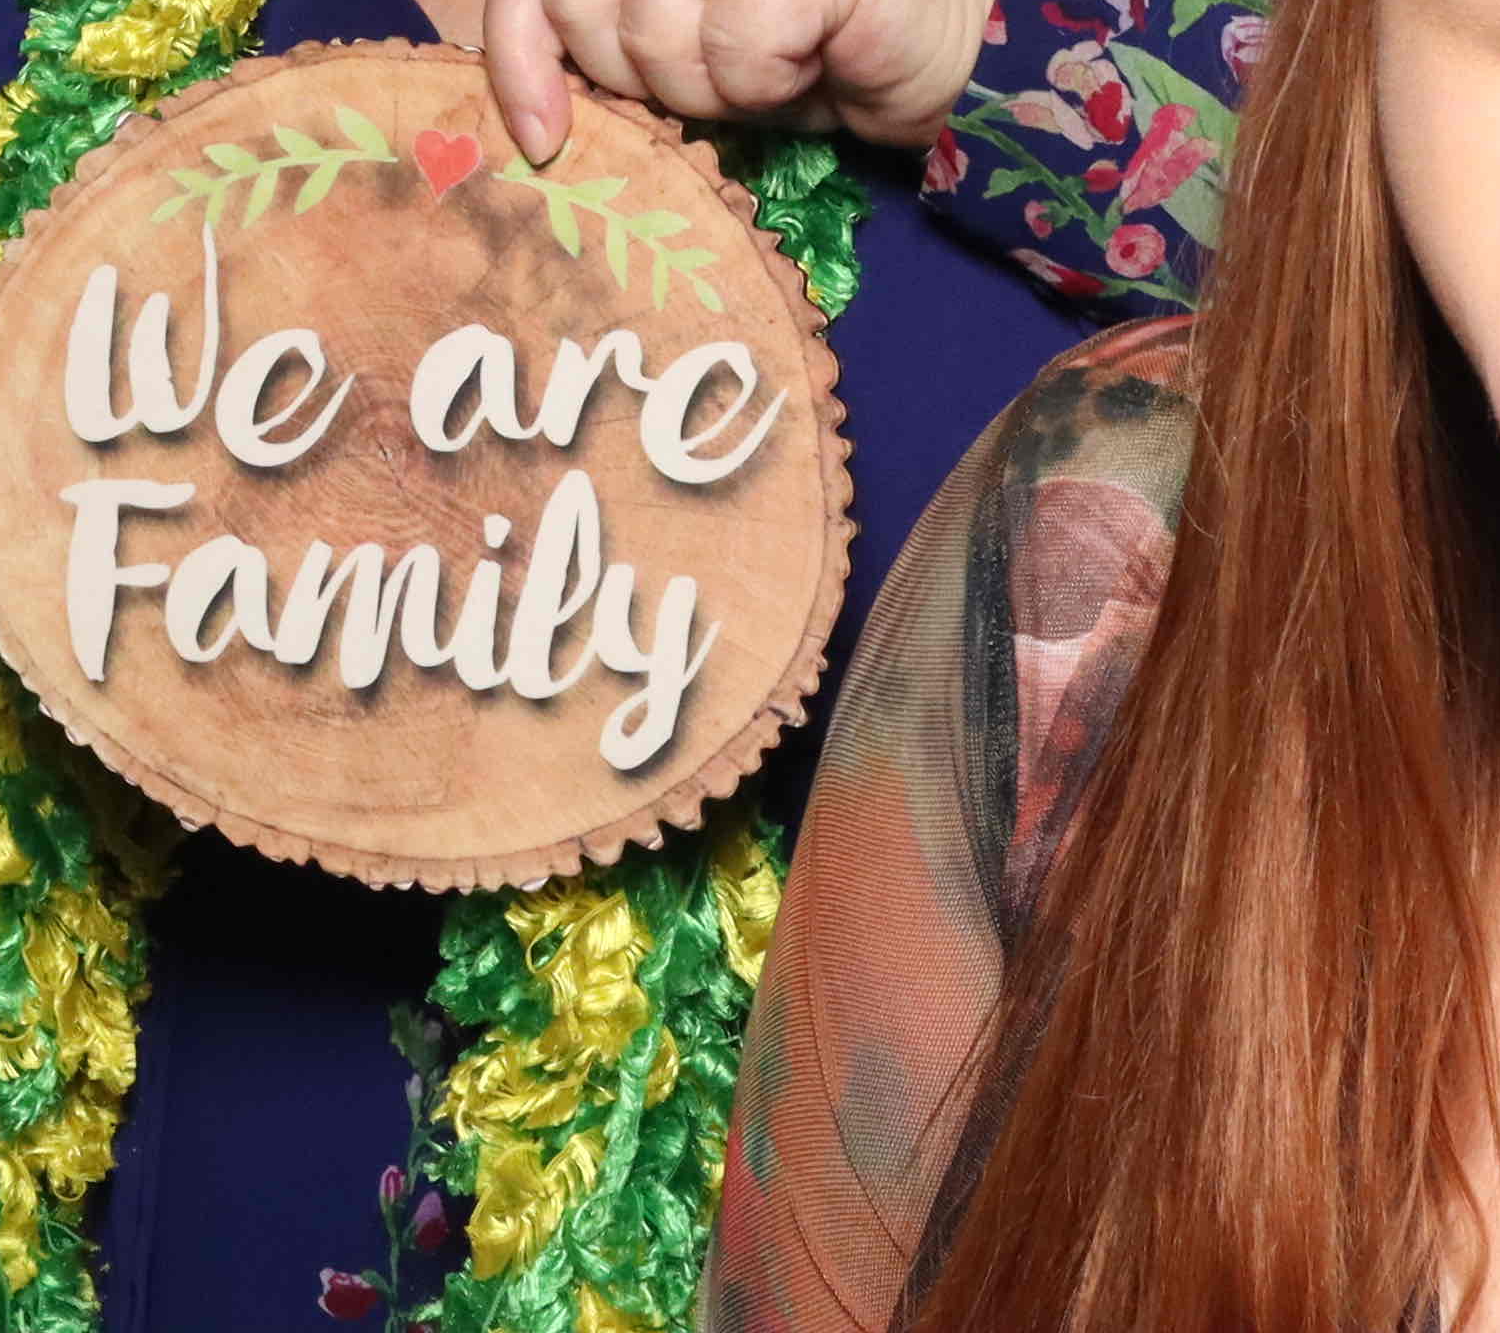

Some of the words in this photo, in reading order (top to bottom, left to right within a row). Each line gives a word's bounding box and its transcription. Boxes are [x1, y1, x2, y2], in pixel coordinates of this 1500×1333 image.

[64, 221, 355, 467] We
[409, 323, 789, 484] are
[60, 469, 720, 770] Family
